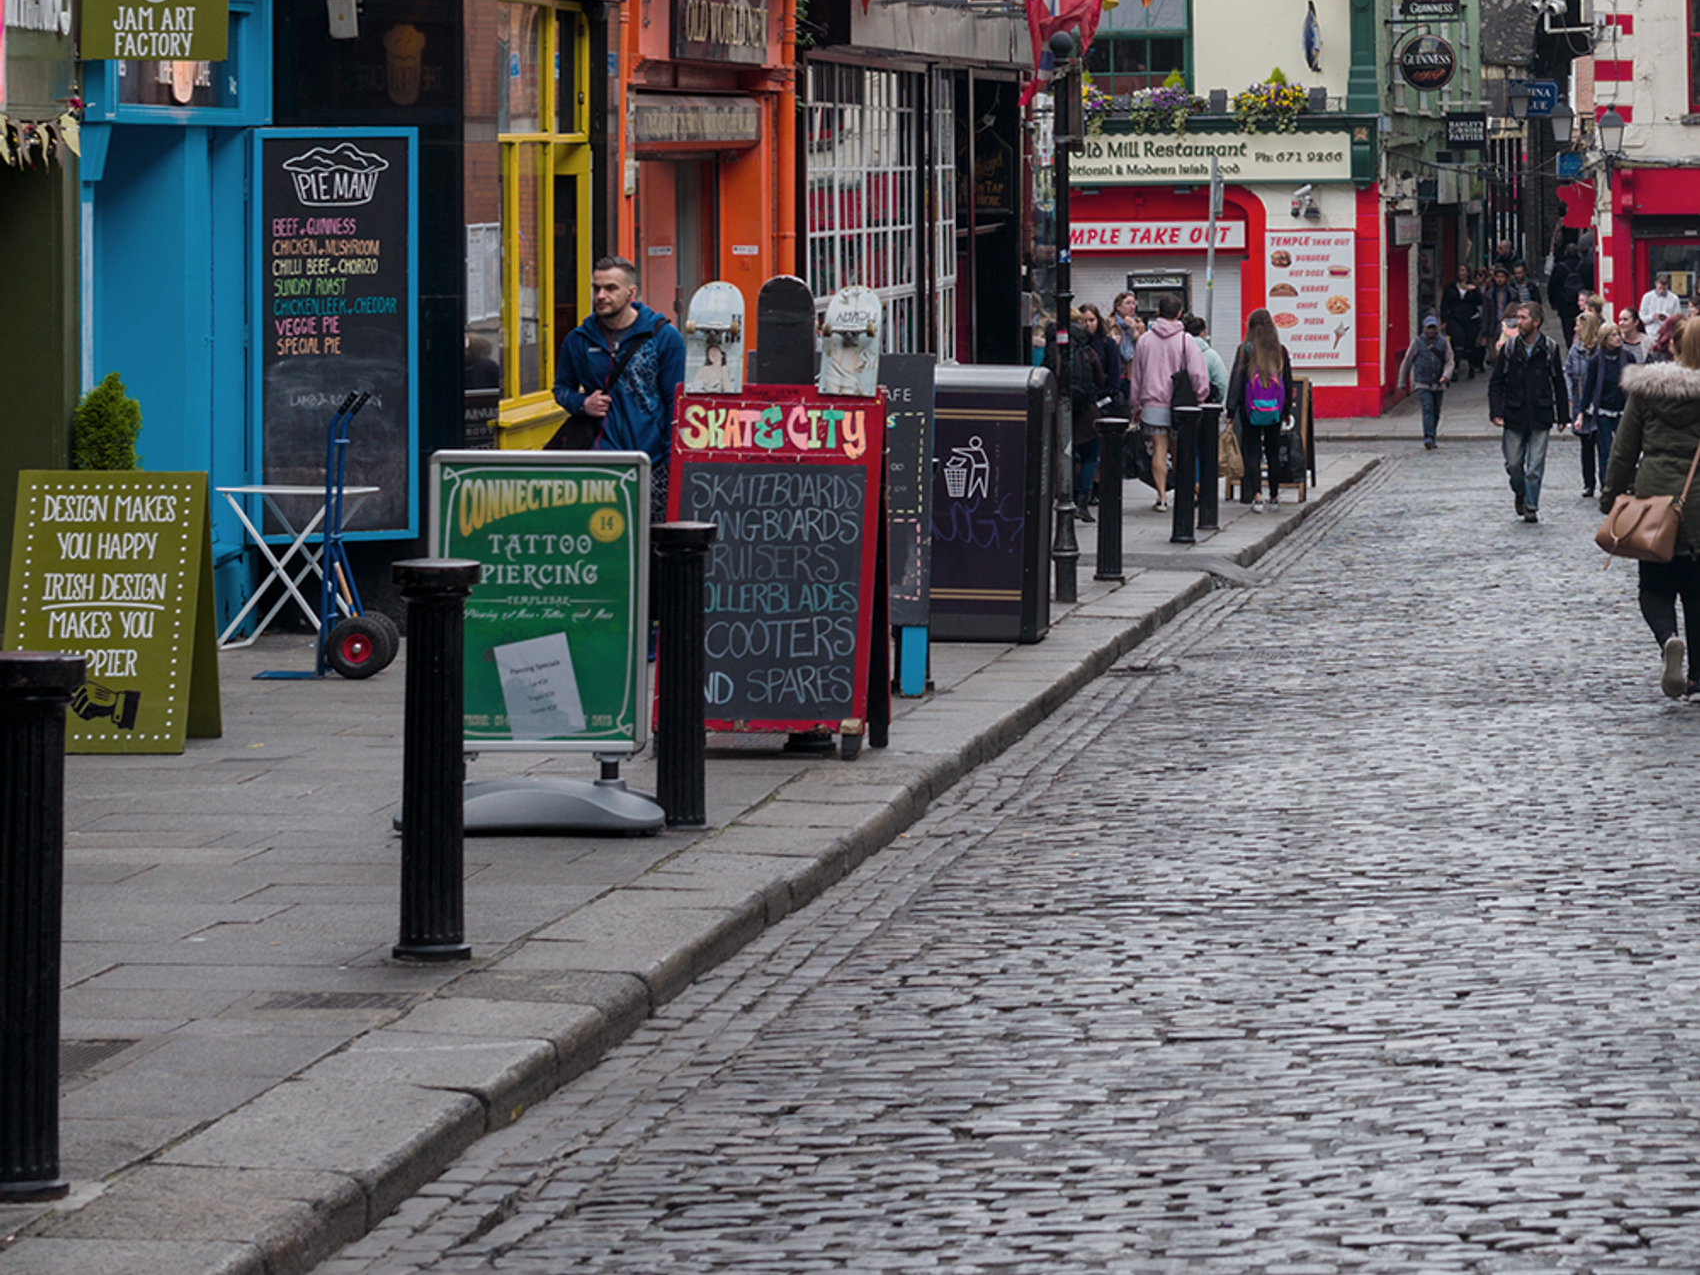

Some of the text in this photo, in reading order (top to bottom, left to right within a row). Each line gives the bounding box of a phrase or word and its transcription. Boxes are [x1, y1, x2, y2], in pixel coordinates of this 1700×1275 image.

[113, 6, 196, 31] JAM ART
[1409, 2, 1454, 14] GUINNESS
[114, 32, 194, 57] FACTORY
[1403, 53, 1452, 65] GUINNESS
[1107, 141, 1140, 158] Mill
[1143, 141, 1247, 158] Restaurant
[1276, 151, 1303, 163] 671
[1306, 151, 1344, 163] 9266
[1116, 165, 1124, 176] &
[1216, 162, 1241, 175] ood
[272, 217, 357, 237] BEEF GUINNESS
[1069, 228, 1122, 245] MPLE
[1129, 227, 1182, 245] TAKE
[272, 238, 380, 257] CHICKEN MUSHROOM
[1270, 236, 1311, 247] TEMPLE
[1334, 238, 1351, 246] OUT
[272, 257, 379, 276] CHILLI BEEF CHORIZO
[1295, 253, 1331, 263] BURGERS
[1289, 268, 1325, 277] HOT DOGS
[274, 277, 348, 297] SUNDAY ROAST
[354, 296, 398, 315] CHEDDAR
[1296, 301, 1319, 310] CHIPS
[275, 315, 341, 336] VEGGIE PIE
[276, 336, 342, 355] SPECIAL PIE
[1290, 333, 1331, 342] ICE CREAM
[679, 404, 784, 450] SKATE
[690, 472, 863, 510] SKATEBOARDS
[42, 494, 178, 523] DESIGN MAKES
[459, 478, 618, 538] CONNECTED INK
[599, 516, 615, 531] 14
[56, 532, 159, 560] YOU HAPPY
[487, 533, 593, 562] TATTOO
[705, 543, 840, 583] RUISERS
[480, 559, 599, 590] PIERCING
[42, 573, 167, 601] IRISH DESIGN
[704, 581, 859, 614] OLLERBLADES
[48, 610, 155, 639] MAKES YOU
[704, 616, 857, 661] COOTERS
[60, 648, 138, 678] PPIER
[704, 664, 853, 705] ND SPARES
